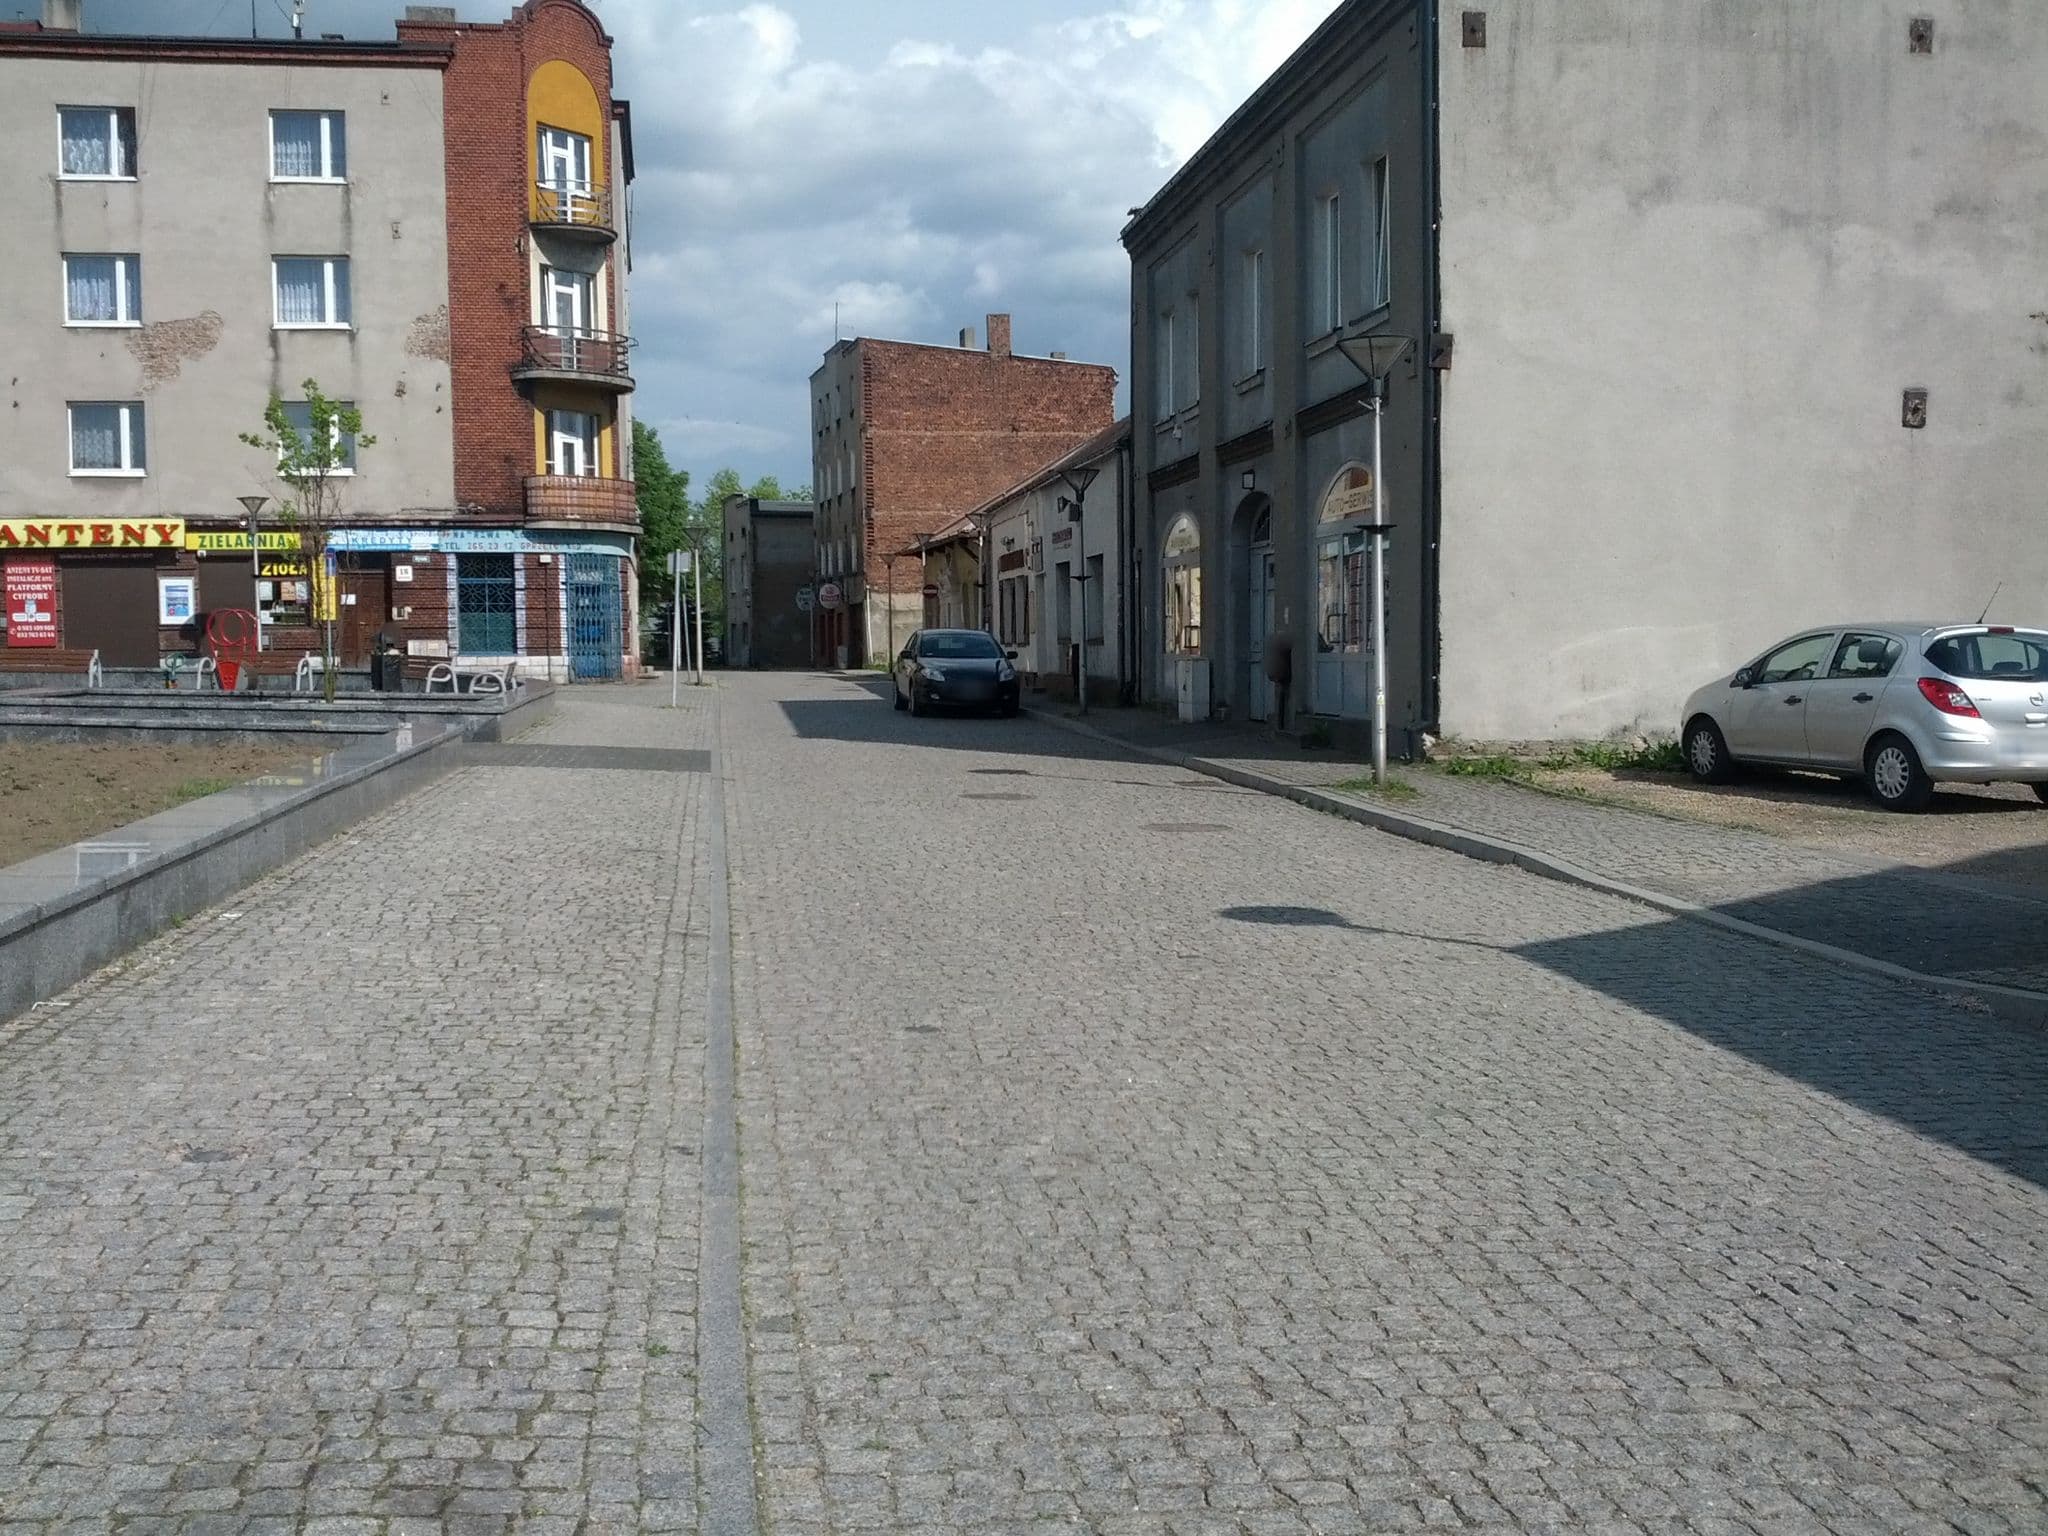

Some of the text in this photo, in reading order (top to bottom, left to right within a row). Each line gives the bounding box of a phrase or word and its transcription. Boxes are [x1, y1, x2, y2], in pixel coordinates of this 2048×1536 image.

[0, 524, 180, 546] ANTENY
[198, 535, 287, 548] ZIELARNIA
[351, 536, 412, 544] KREDYTY
